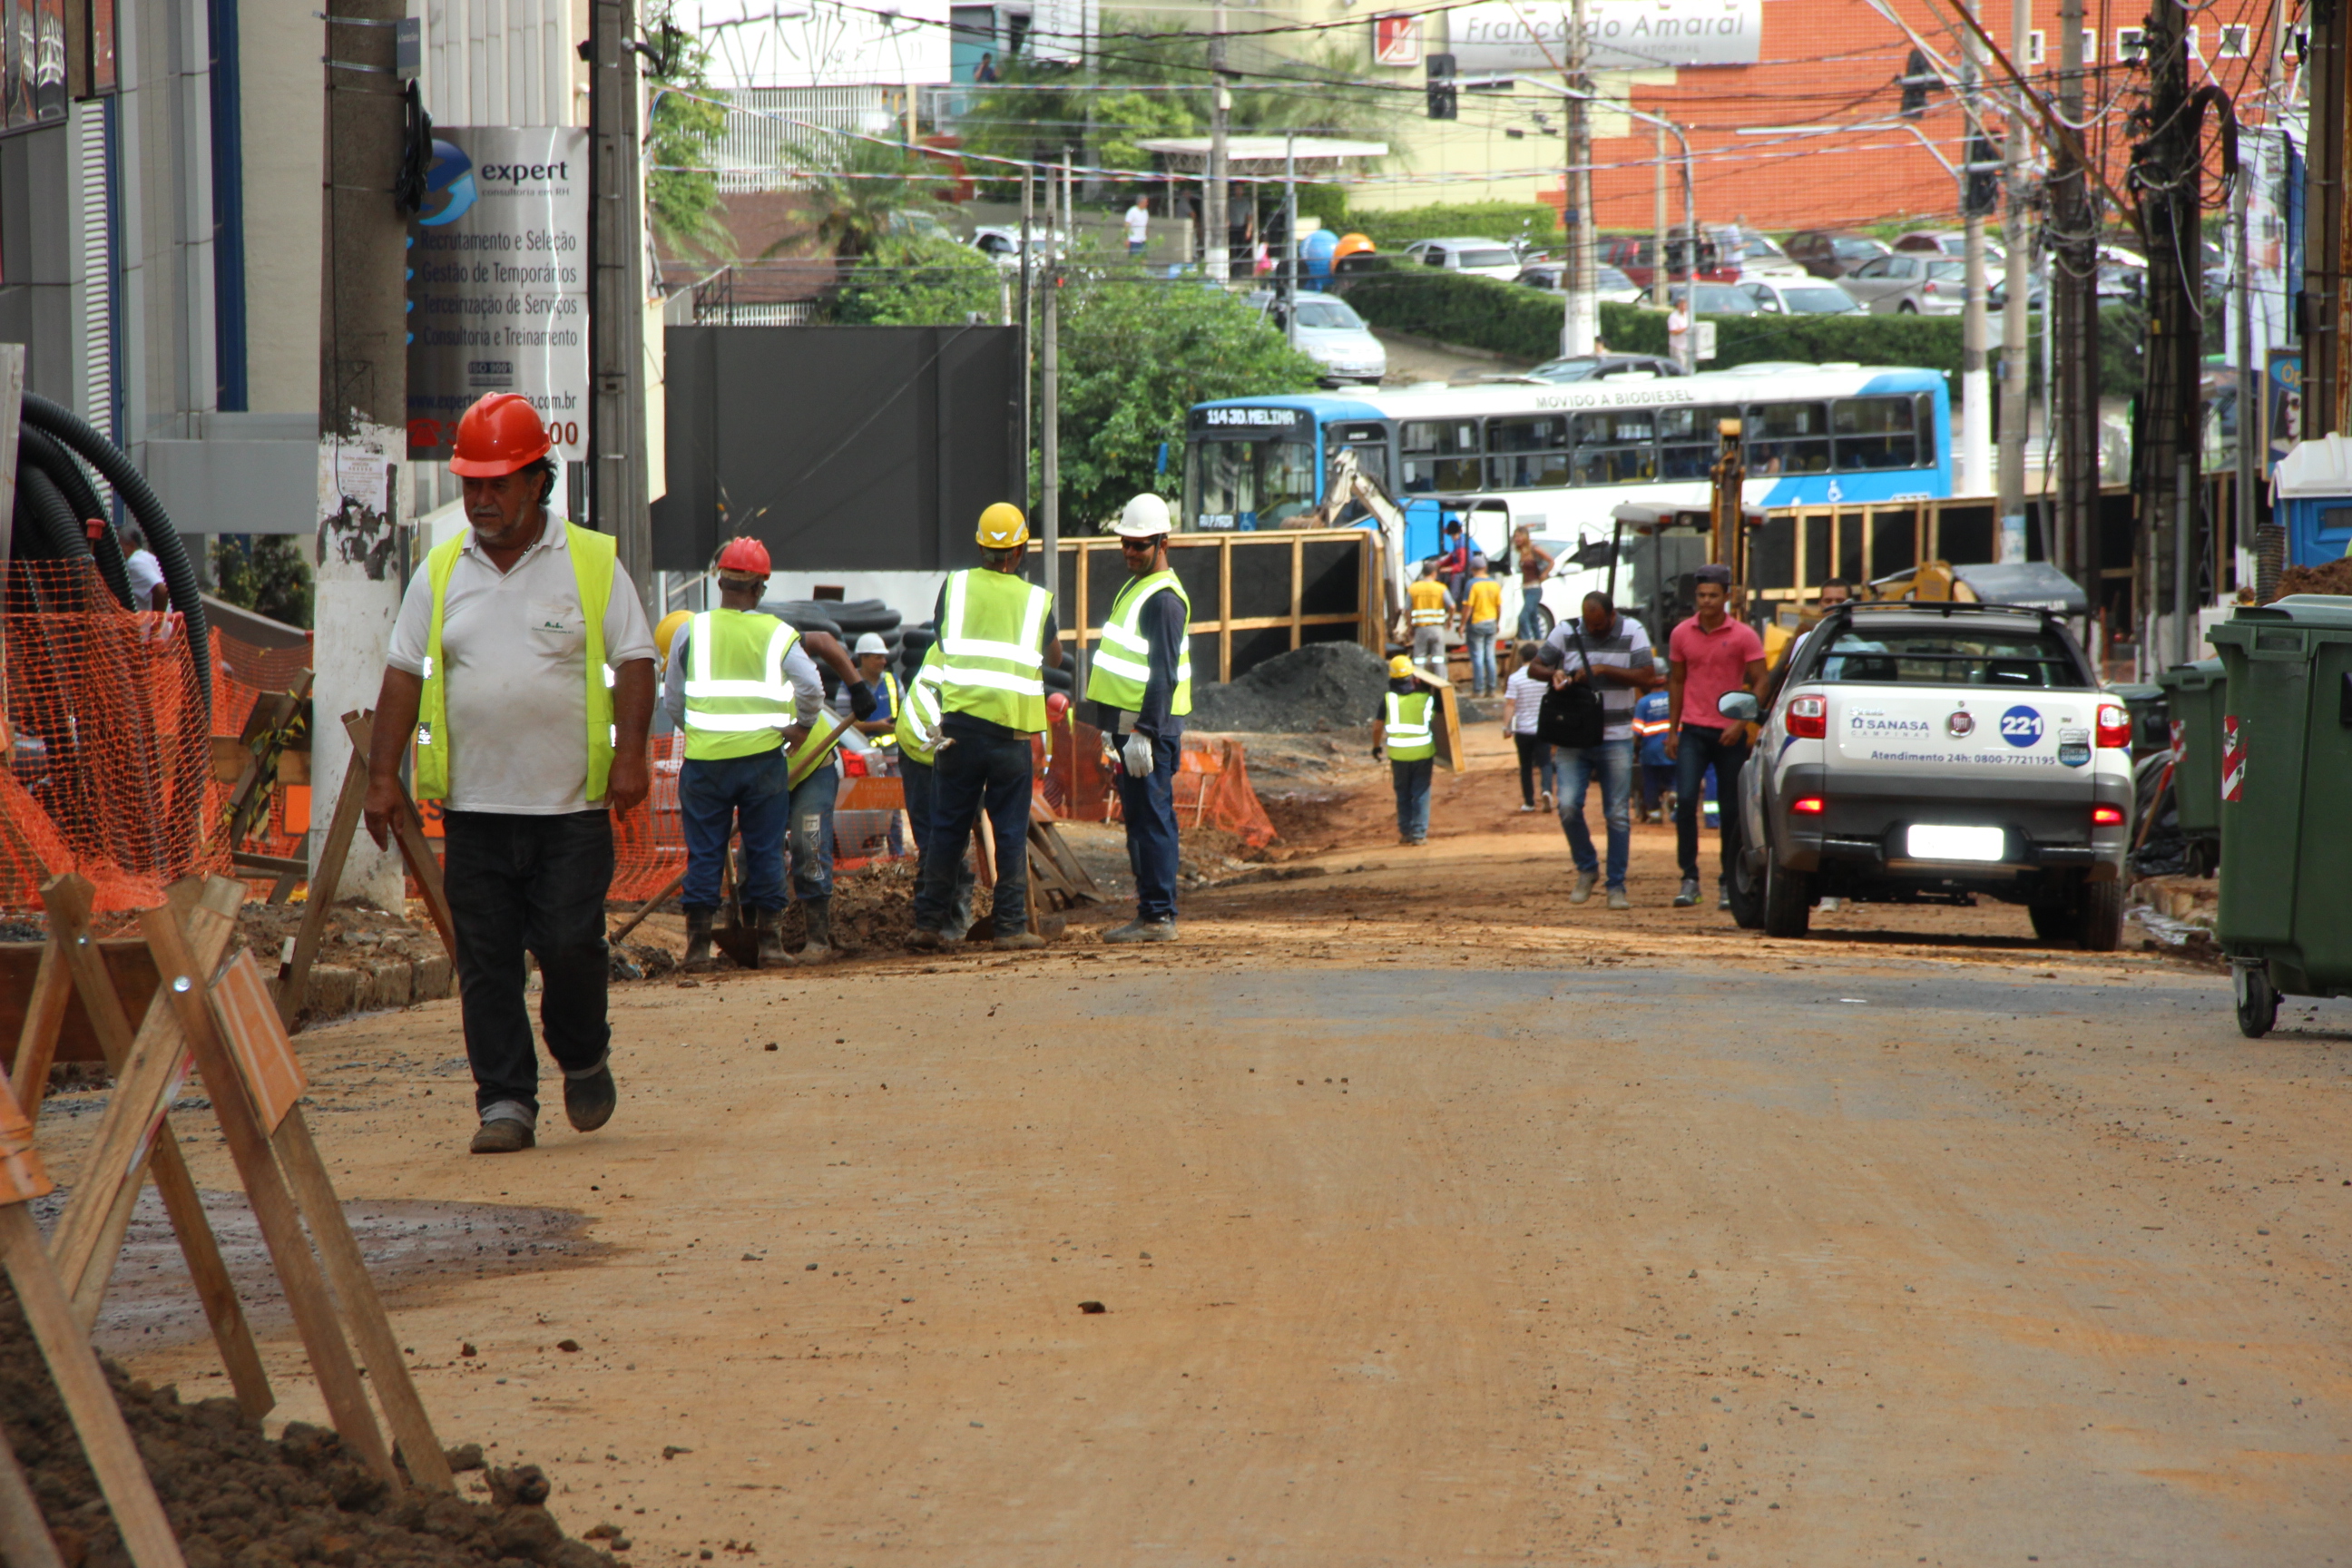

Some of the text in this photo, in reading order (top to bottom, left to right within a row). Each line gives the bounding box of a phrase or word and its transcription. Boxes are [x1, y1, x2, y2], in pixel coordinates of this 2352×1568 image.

[1586, 15, 1621, 38] do
[1632, 13, 1744, 37] Amaral
[481, 162, 569, 186] expert
[481, 187, 570, 197] consultoria em RH
[420, 230, 576, 257] Recrutamento e Seleção
[422, 260, 577, 289] Gestão de Temporários
[506, 292, 521, 315] de
[524, 293, 577, 320] Serviços
[423, 326, 578, 347] Consultoria e Treinamento
[469, 363, 514, 374] ISO 9001
[1535, 389, 1695, 409] MOVIDO A BIODIESEL
[1207, 409, 1228, 425] 114
[1867, 719, 1930, 731] SANASA
[1953, 717, 1970, 729] FIAT
[2002, 716, 2043, 736] 221
[1851, 730, 1930, 739] CAMPINAS
[1870, 750, 2056, 766] Atendimento 24h: 0800-7721195
